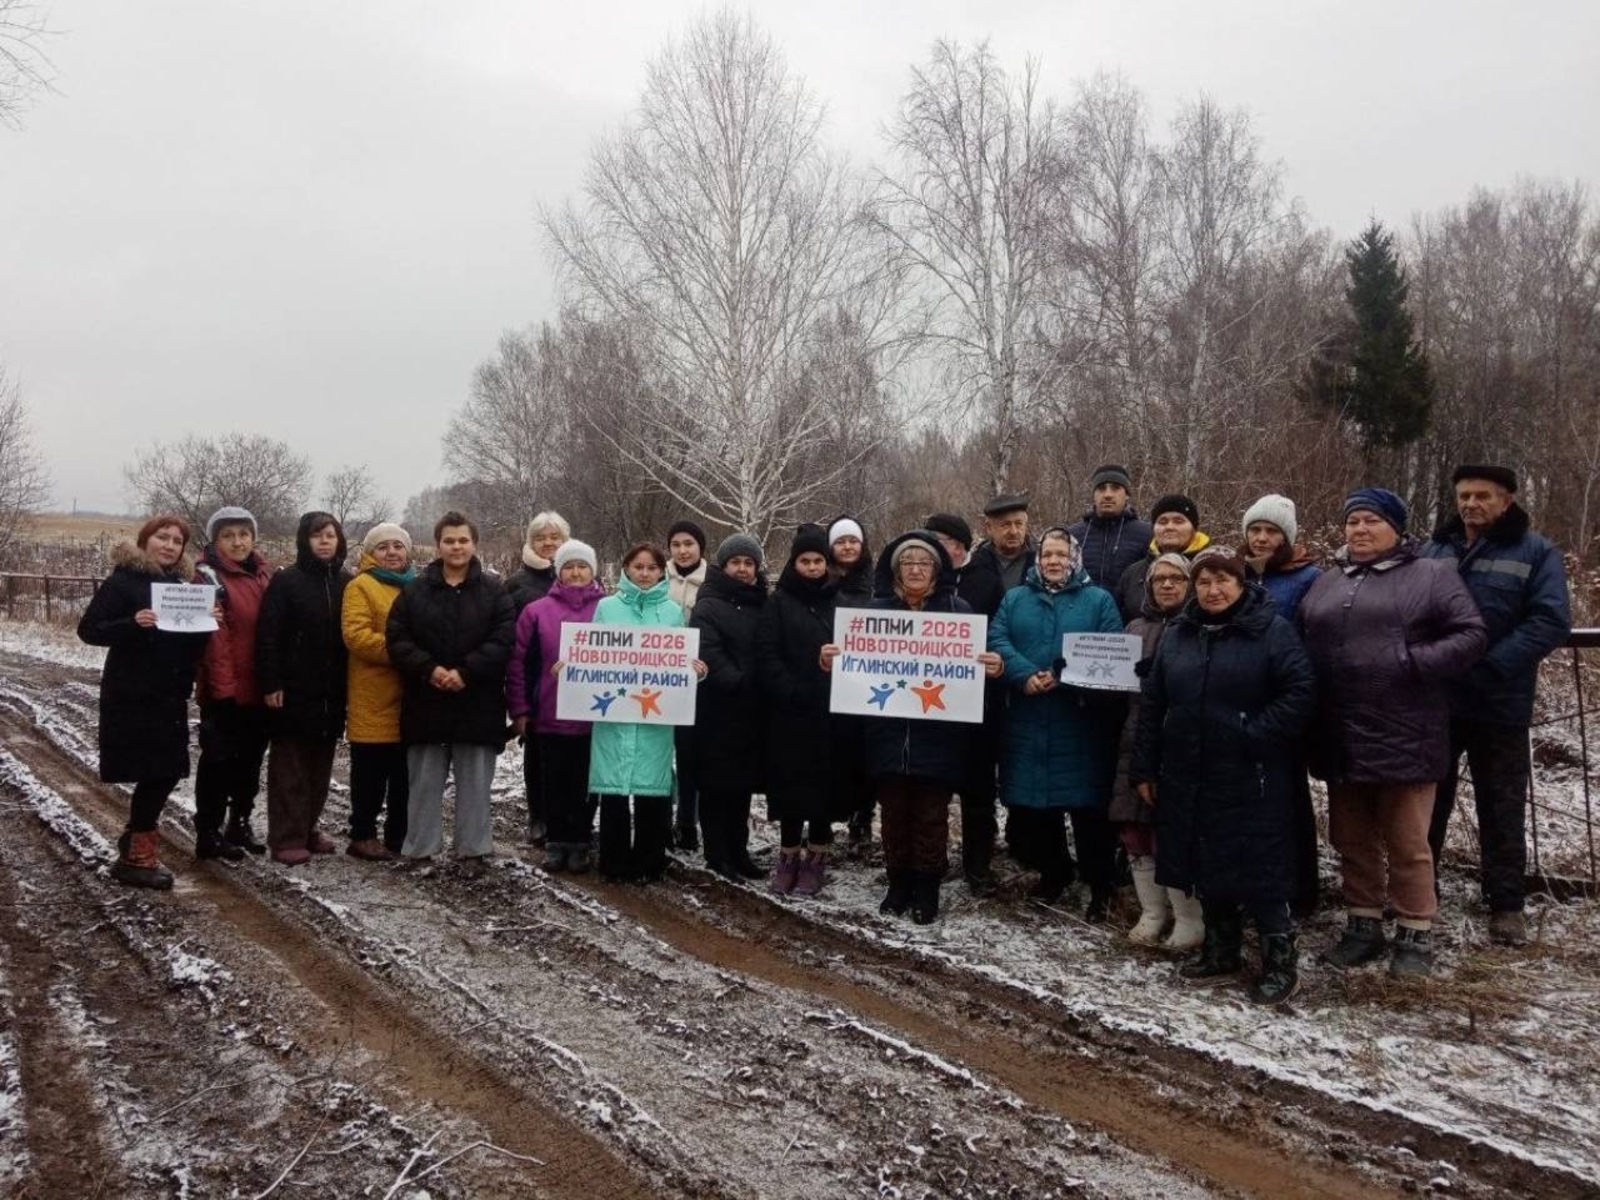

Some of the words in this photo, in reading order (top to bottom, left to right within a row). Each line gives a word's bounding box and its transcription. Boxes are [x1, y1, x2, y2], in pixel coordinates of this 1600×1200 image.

[850, 616, 914, 635] #ППМИ
[922, 620, 971, 639] 2026
[574, 630, 633, 647] #ППМИ
[641, 633, 685, 649] 2026
[642, 671, 688, 687] РАЙОН
[923, 662, 975, 680] РАЙОН
